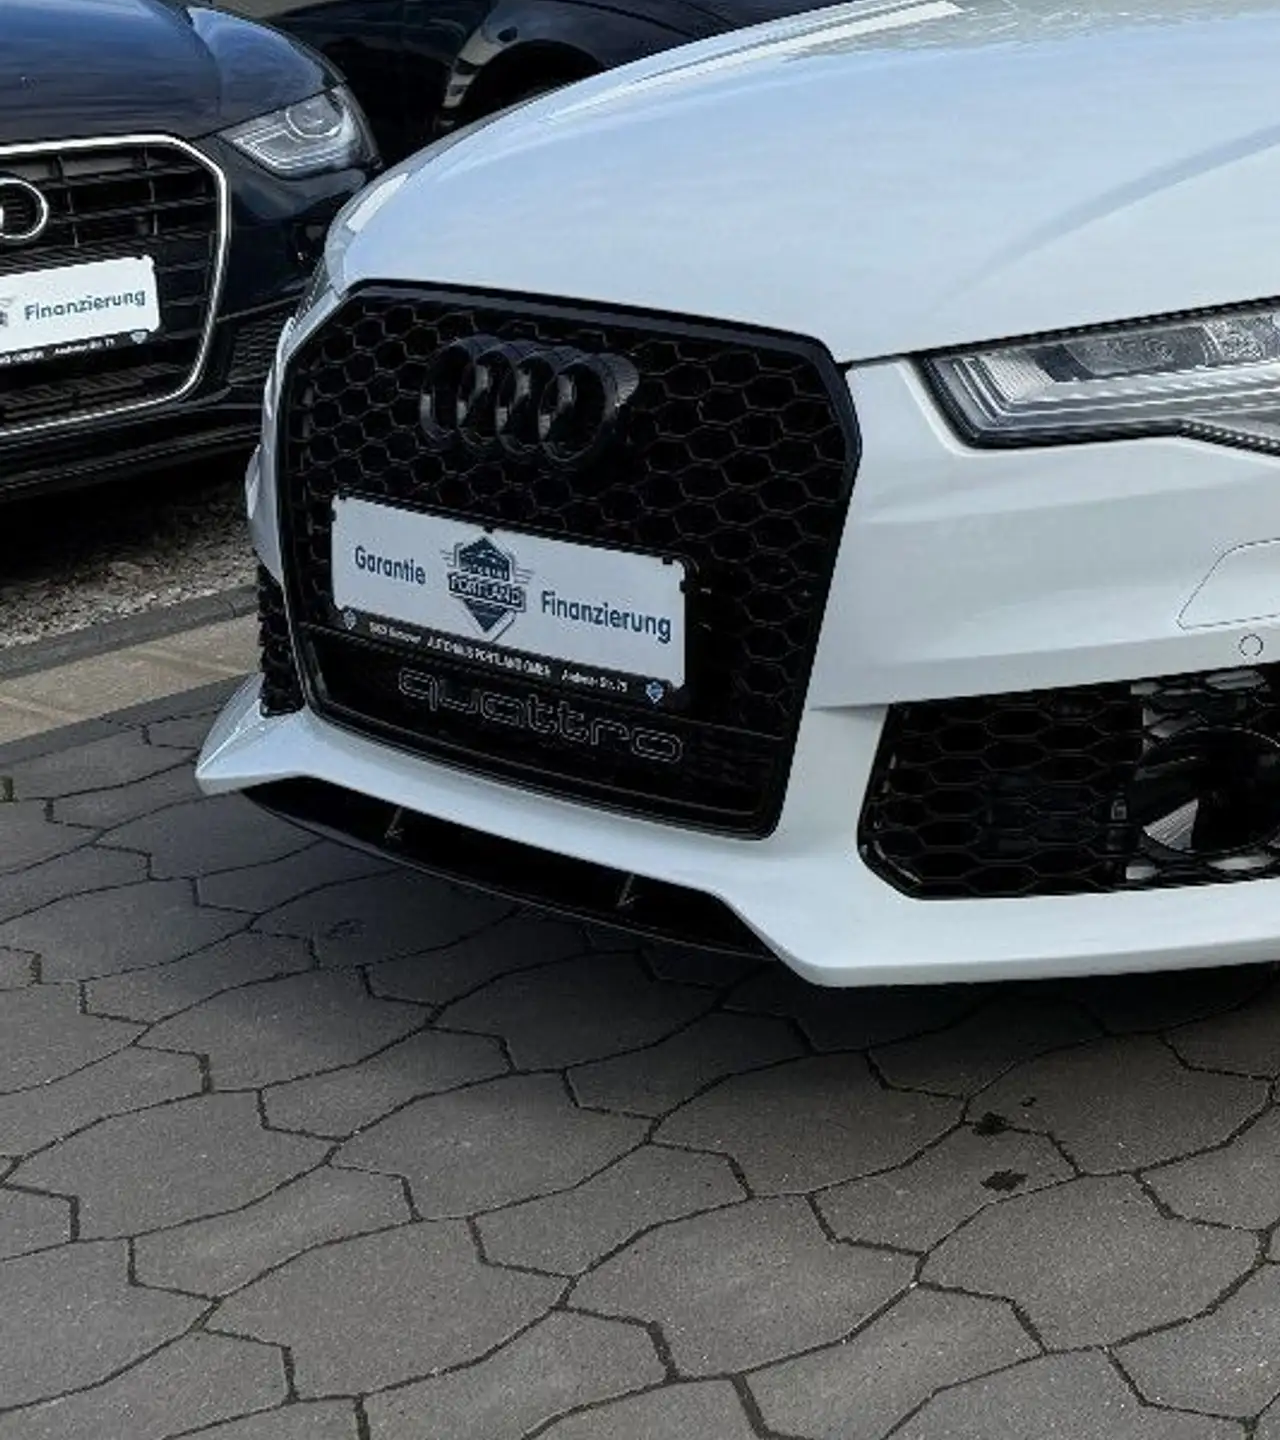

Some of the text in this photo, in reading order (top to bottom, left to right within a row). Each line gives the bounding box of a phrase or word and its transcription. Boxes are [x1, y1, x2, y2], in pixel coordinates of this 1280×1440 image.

[24, 290, 146, 321] Finanzierung
[354, 545, 426, 586] Garantie
[541, 590, 673, 644] Finanzierung
[400, 667, 683, 763] quattro
